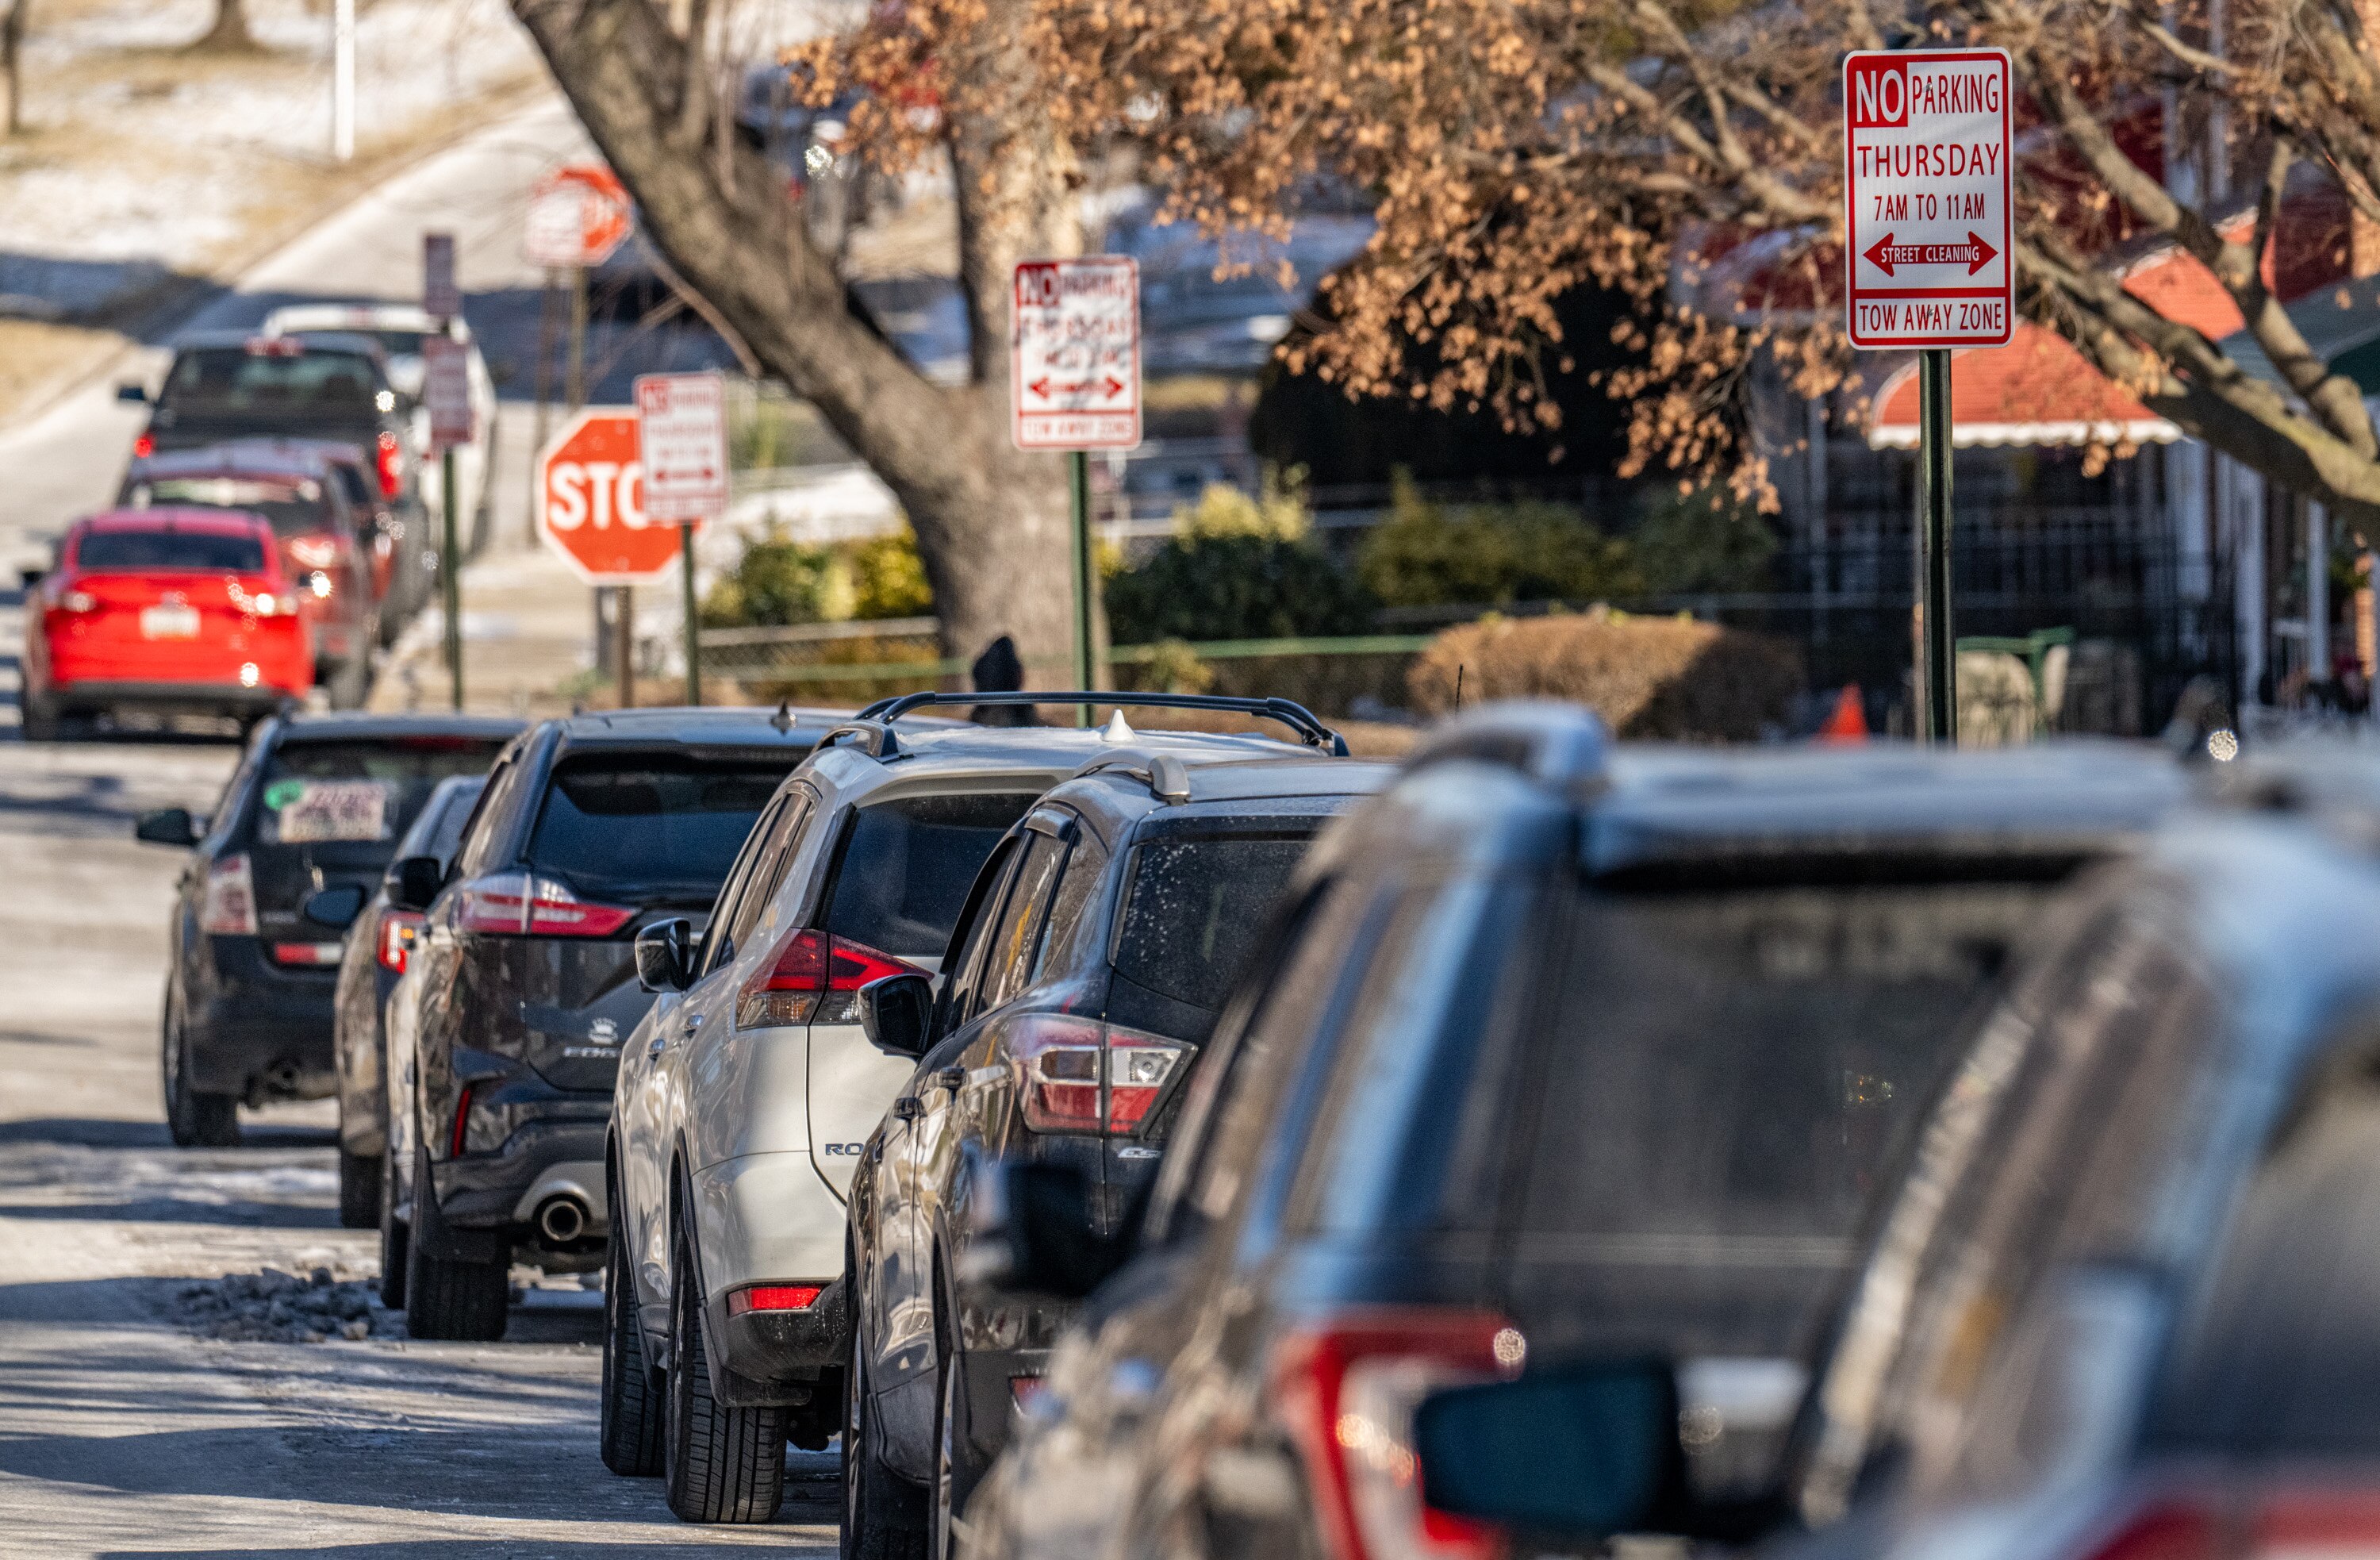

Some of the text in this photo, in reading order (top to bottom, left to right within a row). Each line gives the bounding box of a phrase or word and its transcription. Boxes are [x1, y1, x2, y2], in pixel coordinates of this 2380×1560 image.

[1856, 69, 1998, 124] NO PARKING
[1856, 143, 2000, 178] THURSDAY
[1874, 192, 1985, 221] 7AM TO 11AM
[1880, 244, 1980, 263] STREET CLEANING
[1859, 302, 2002, 332] TOW AWAY ZONE
[549, 460, 649, 531] STO
[824, 1142, 865, 1156] RO
